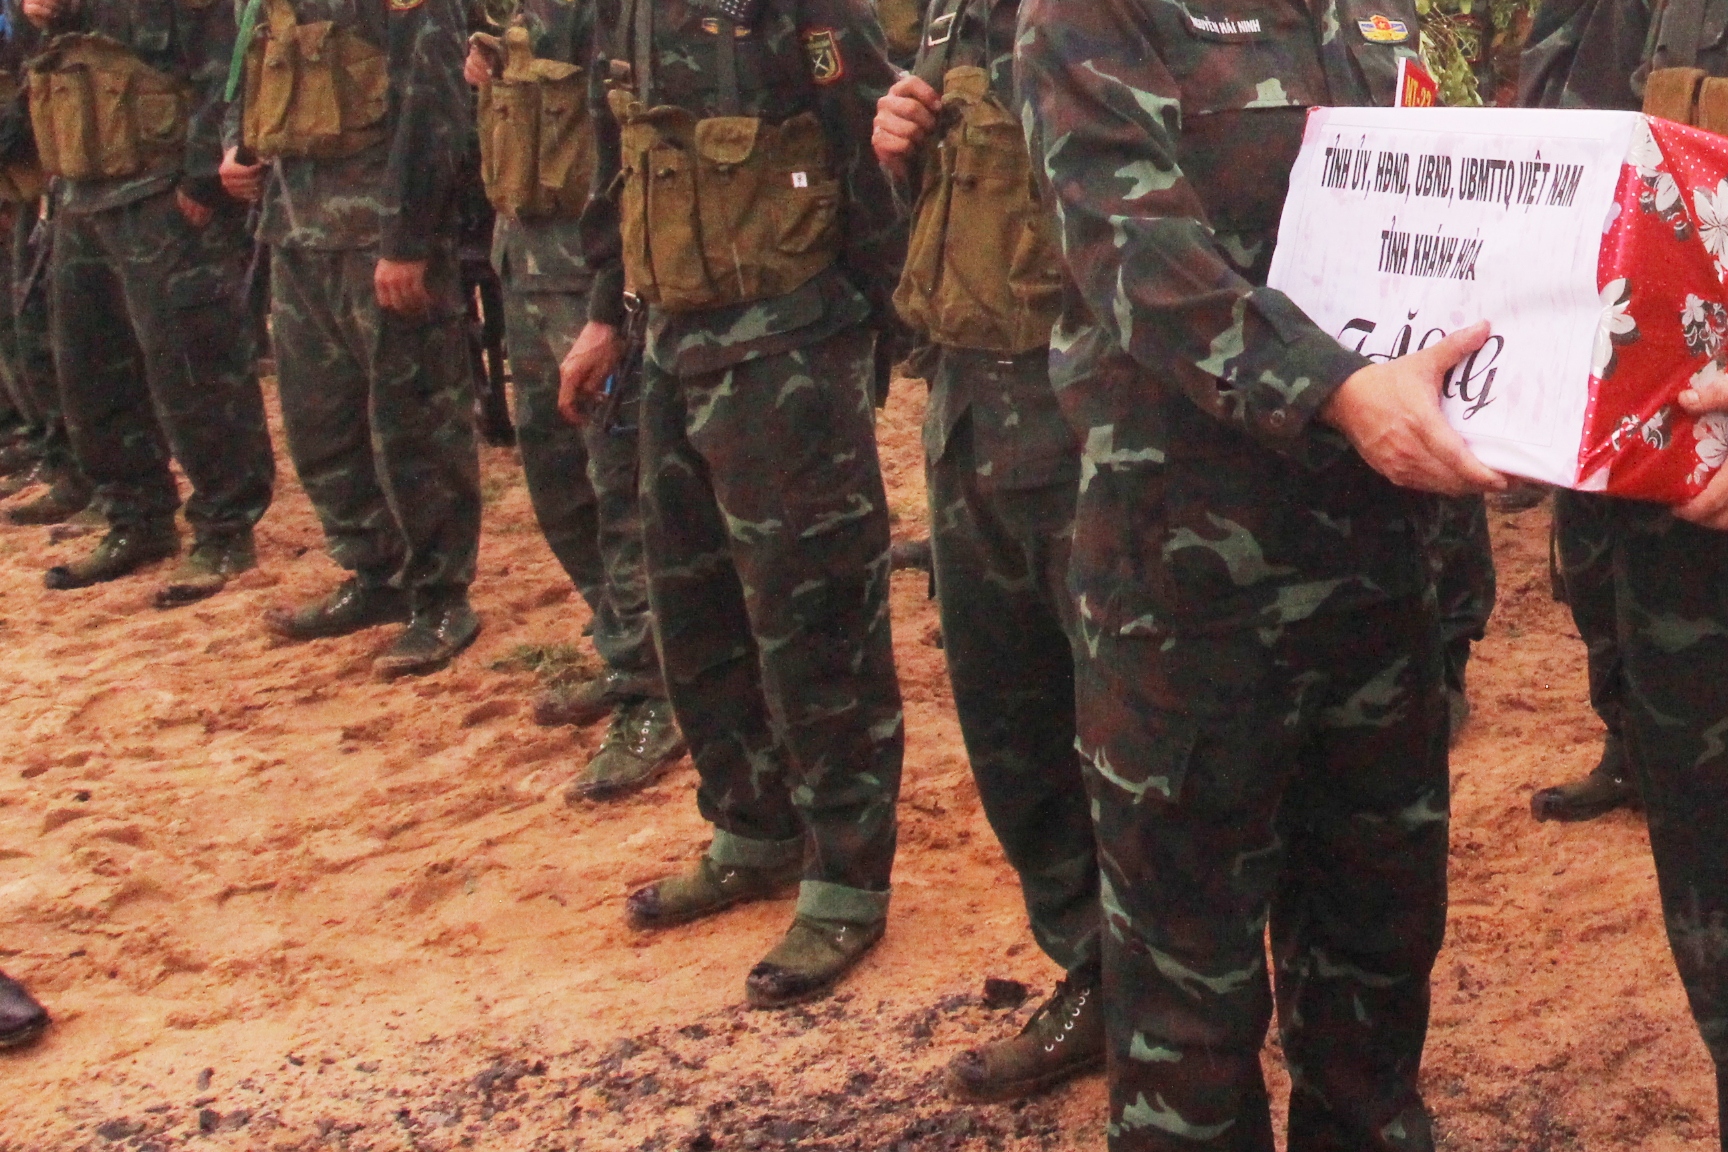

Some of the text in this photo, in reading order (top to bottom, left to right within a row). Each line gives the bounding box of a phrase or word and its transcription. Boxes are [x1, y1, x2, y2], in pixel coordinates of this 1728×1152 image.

[1237, 18, 1262, 34] NINH
[1321, 133, 1353, 190] TỈNH
[1415, 154, 1454, 208] UBND,
[1459, 157, 1515, 212] UBMTTQ
[1516, 149, 1551, 214] VIỆT
[1545, 163, 1584, 208] NAM
[1378, 215, 1410, 275] TỈNH
[1410, 223, 1459, 278] KHÁNH
